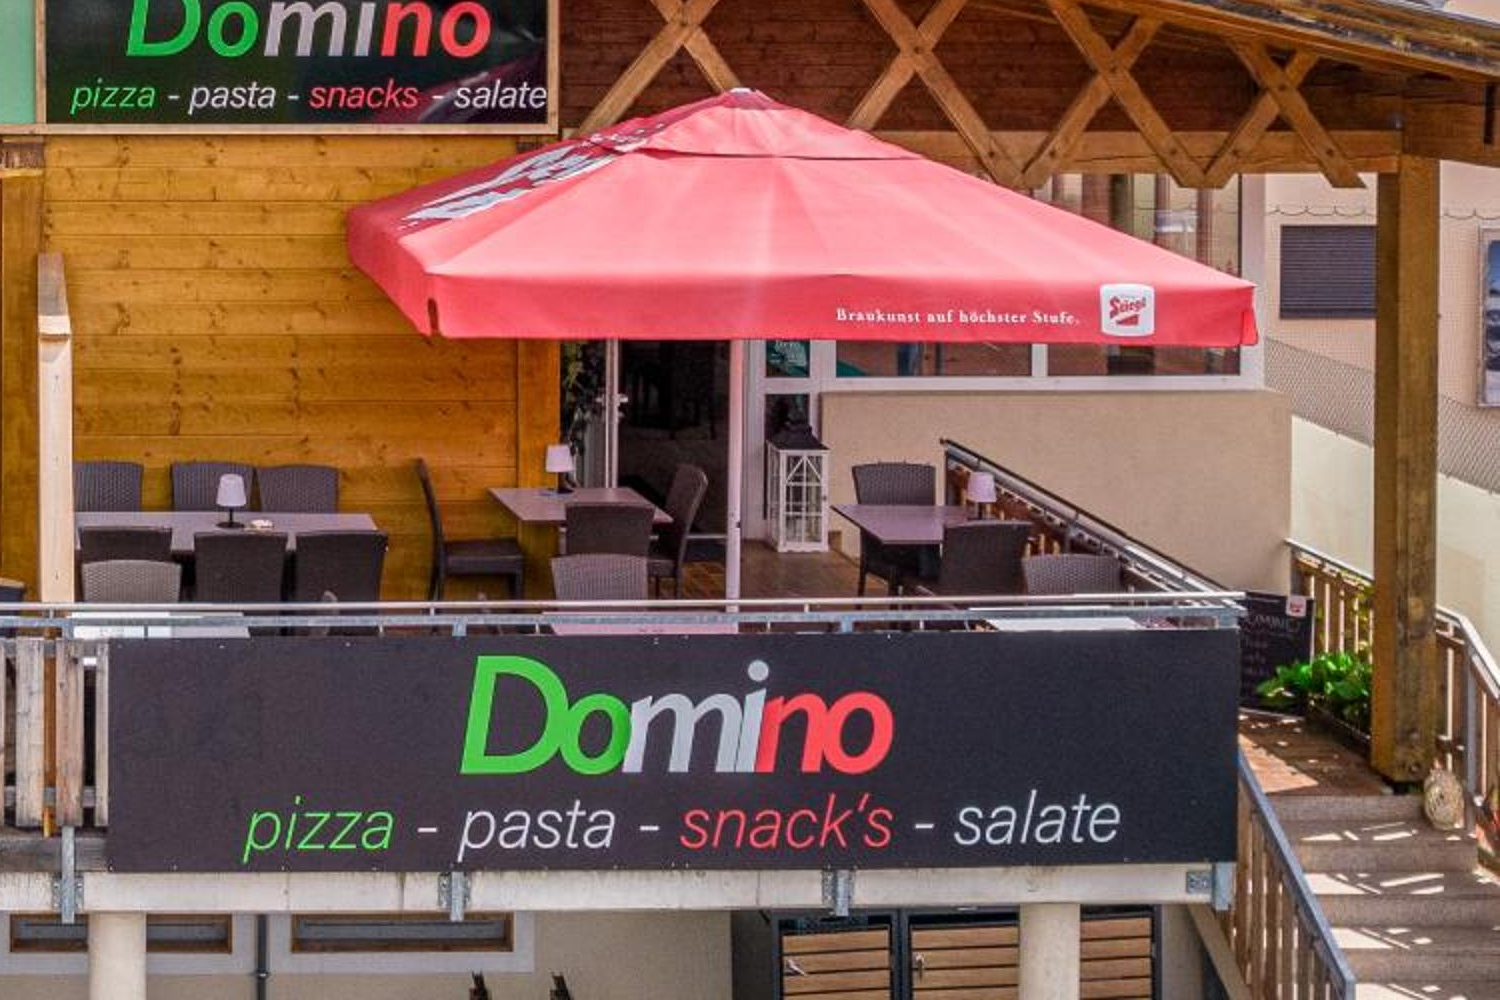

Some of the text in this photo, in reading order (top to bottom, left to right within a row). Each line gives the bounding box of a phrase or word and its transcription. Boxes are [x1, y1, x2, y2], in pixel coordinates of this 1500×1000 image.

[70, 78, 156, 115] pizza
[187, 81, 277, 116] pasta
[308, 77, 419, 109] snacks
[453, 79, 548, 110] salate
[836, 308, 1080, 325] Braukunst auf höchster Stufe.
[460, 655, 894, 775] Domino
[243, 795, 394, 863] pizza
[457, 799, 616, 863] pasta
[953, 788, 1121, 846] salate
